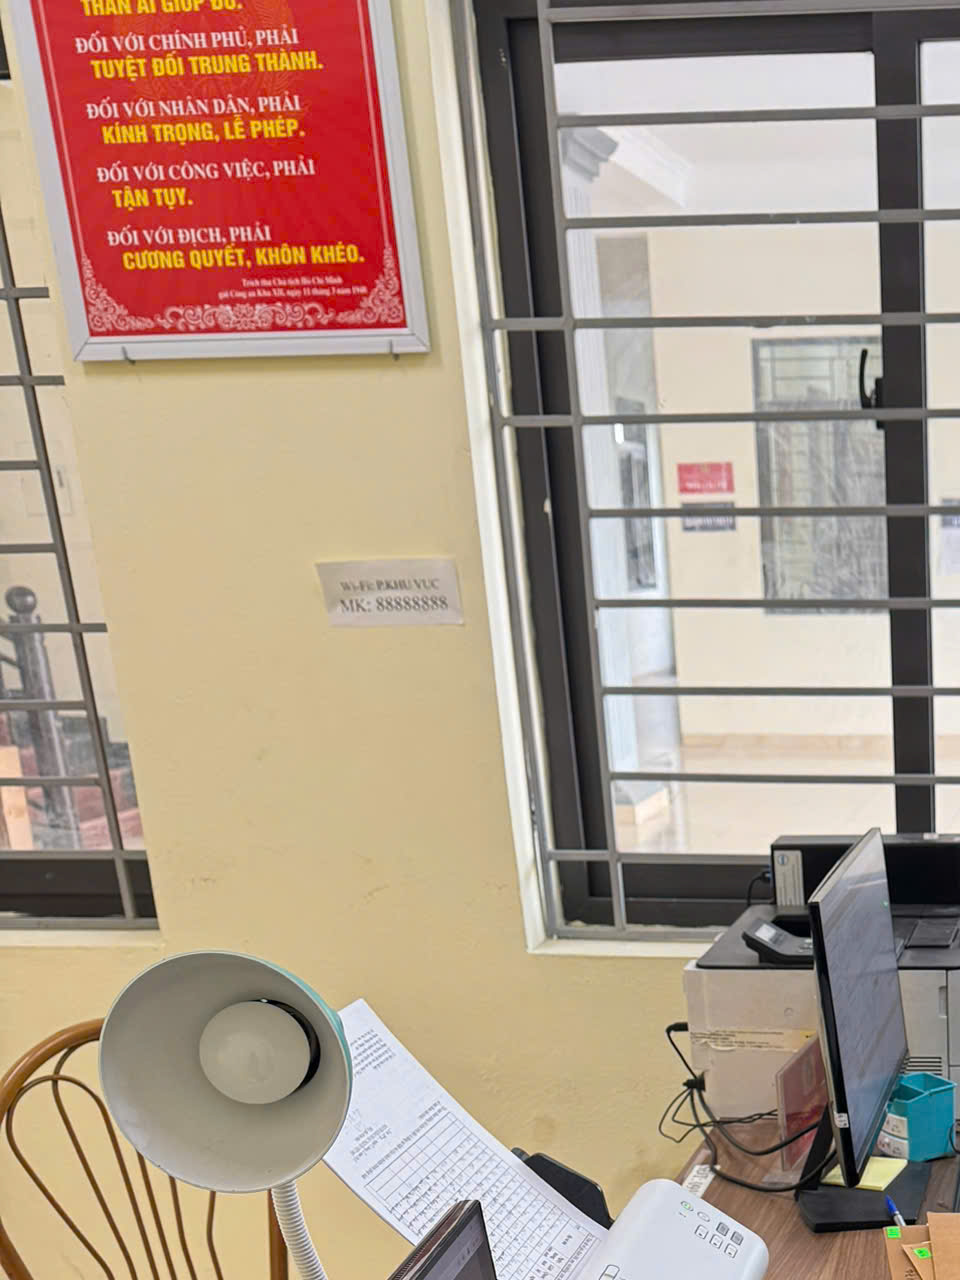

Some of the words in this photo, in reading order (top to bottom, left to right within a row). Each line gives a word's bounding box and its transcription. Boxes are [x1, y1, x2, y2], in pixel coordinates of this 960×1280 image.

[75, 31, 108, 53] ĐỐI
[112, 33, 145, 52] VỚI
[148, 30, 207, 51] CHÍNH
[211, 26, 253, 49] PHỦ,
[255, 24, 299, 46] PHẢI
[91, 56, 146, 81] TUYỆT
[152, 51, 184, 77] ĐỐI
[188, 54, 250, 74] TRUNG
[255, 49, 323, 72] THÀNH.
[86, 97, 119, 119] ĐỐI
[122, 98, 155, 117] VỚI
[158, 96, 210, 116] NHÂN
[213, 94, 255, 116] DÂN,
[258, 91, 300, 112] PHẢI
[102, 123, 148, 145] KÍNH
[152, 121, 220, 146] TRỌNG,
[223, 115, 246, 140] LỄ
[251, 116, 305, 139] PHÉP.
[96, 161, 129, 182] ĐỐI
[132, 163, 164, 181] VỚI
[168, 160, 219, 180] CÔNG
[223, 158, 270, 180] VIỆC,
[273, 154, 315, 177] PHẢI
[112, 185, 149, 211] TẬN
[152, 187, 193, 211] TỤY.
[107, 225, 139, 246] ĐỐI
[143, 226, 174, 245] VỚI
[177, 226, 227, 246] ĐỊCH,
[229, 221, 272, 243] PHẢI
[122, 250, 185, 270] CƯƠNG
[189, 243, 251, 269] QUYẾT,
[255, 243, 306, 265] KHÔN
[310, 241, 364, 264] KHÉO.
